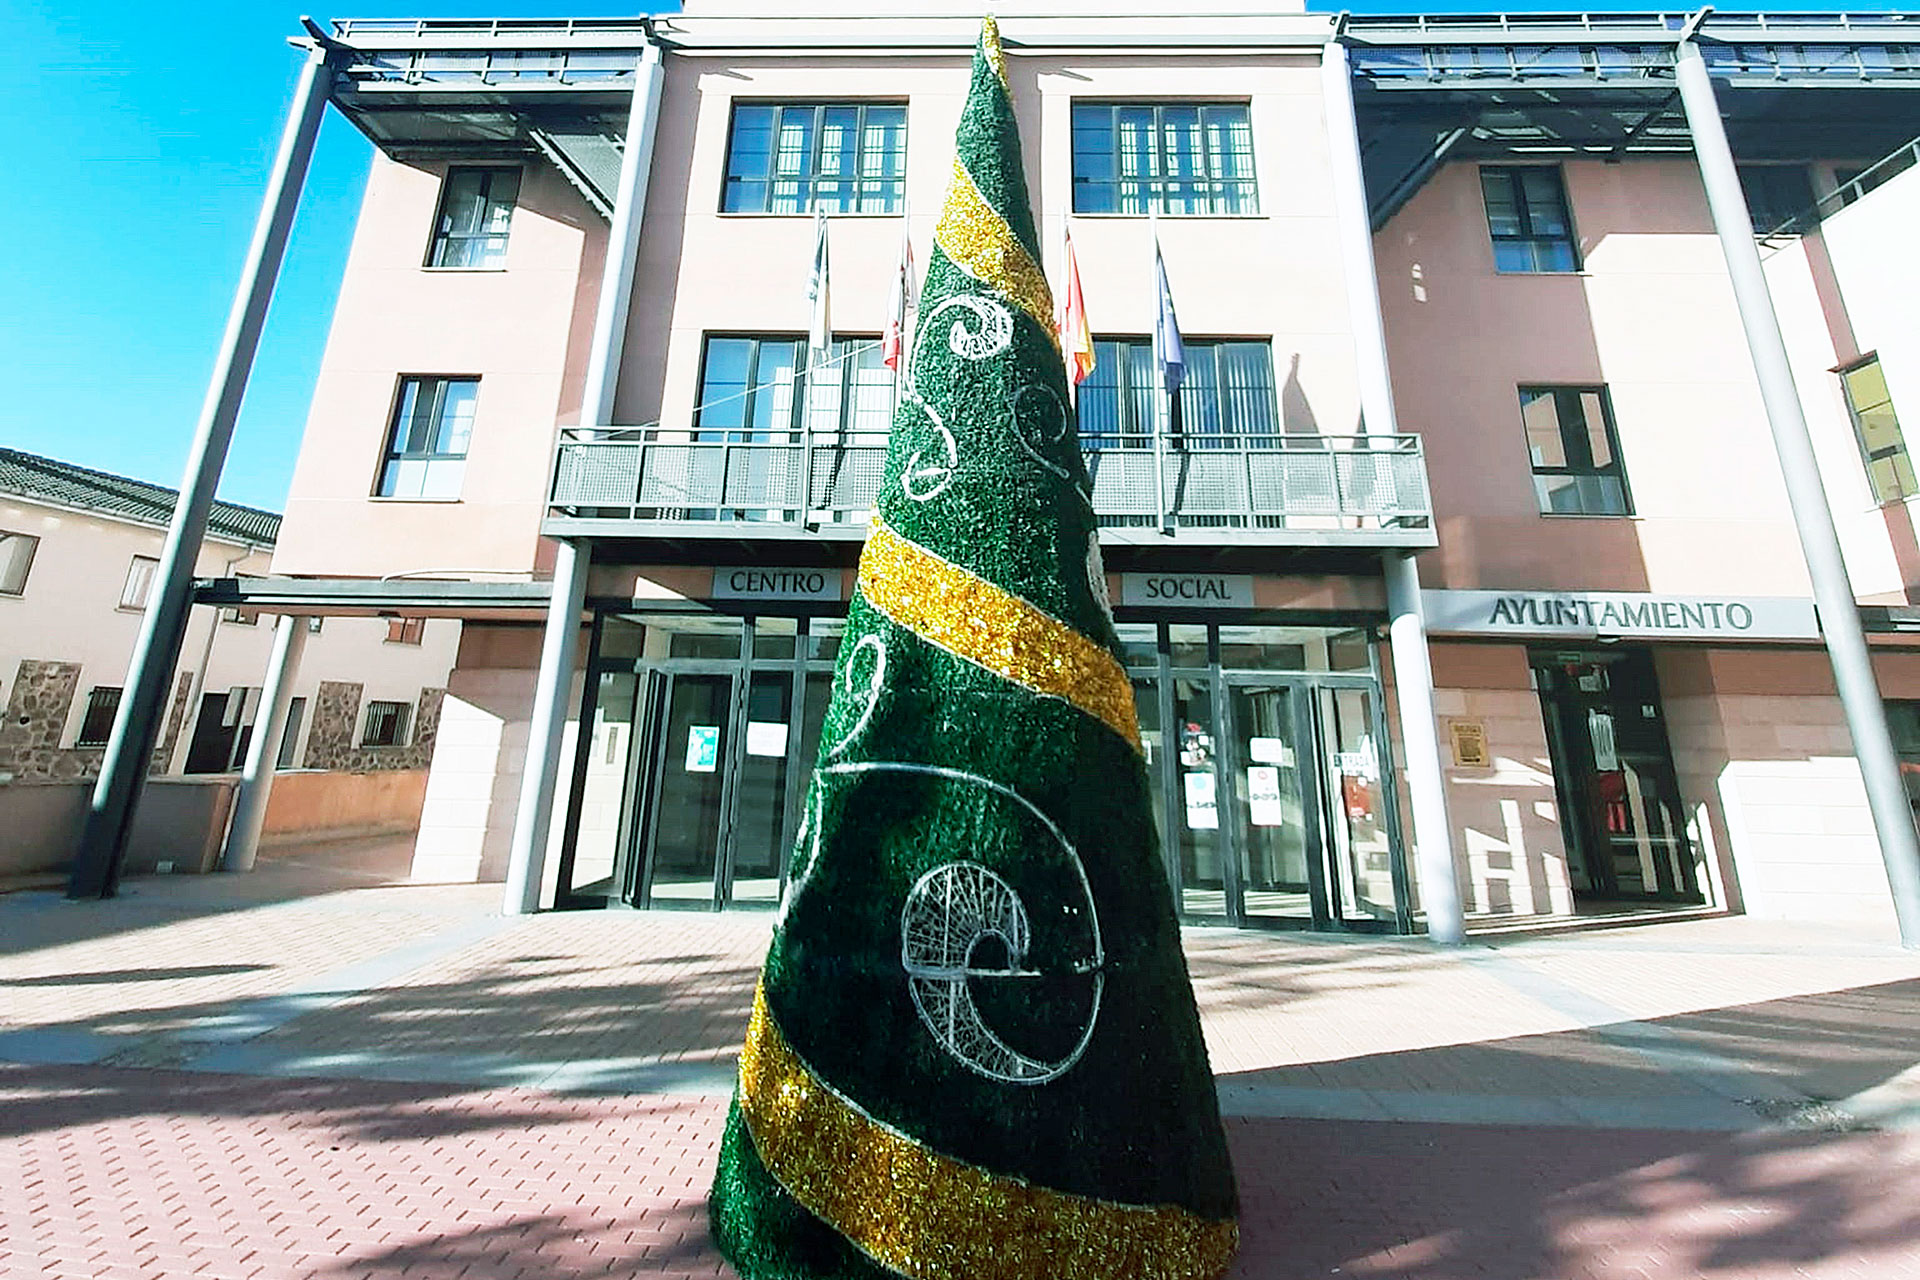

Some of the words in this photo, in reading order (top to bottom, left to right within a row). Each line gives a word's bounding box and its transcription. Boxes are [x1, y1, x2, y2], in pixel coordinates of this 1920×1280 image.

[730, 571, 825, 593] CENTRO
[1146, 578, 1232, 600] SOCIAL
[1488, 597, 1753, 630] AYUNTAMIENTO
